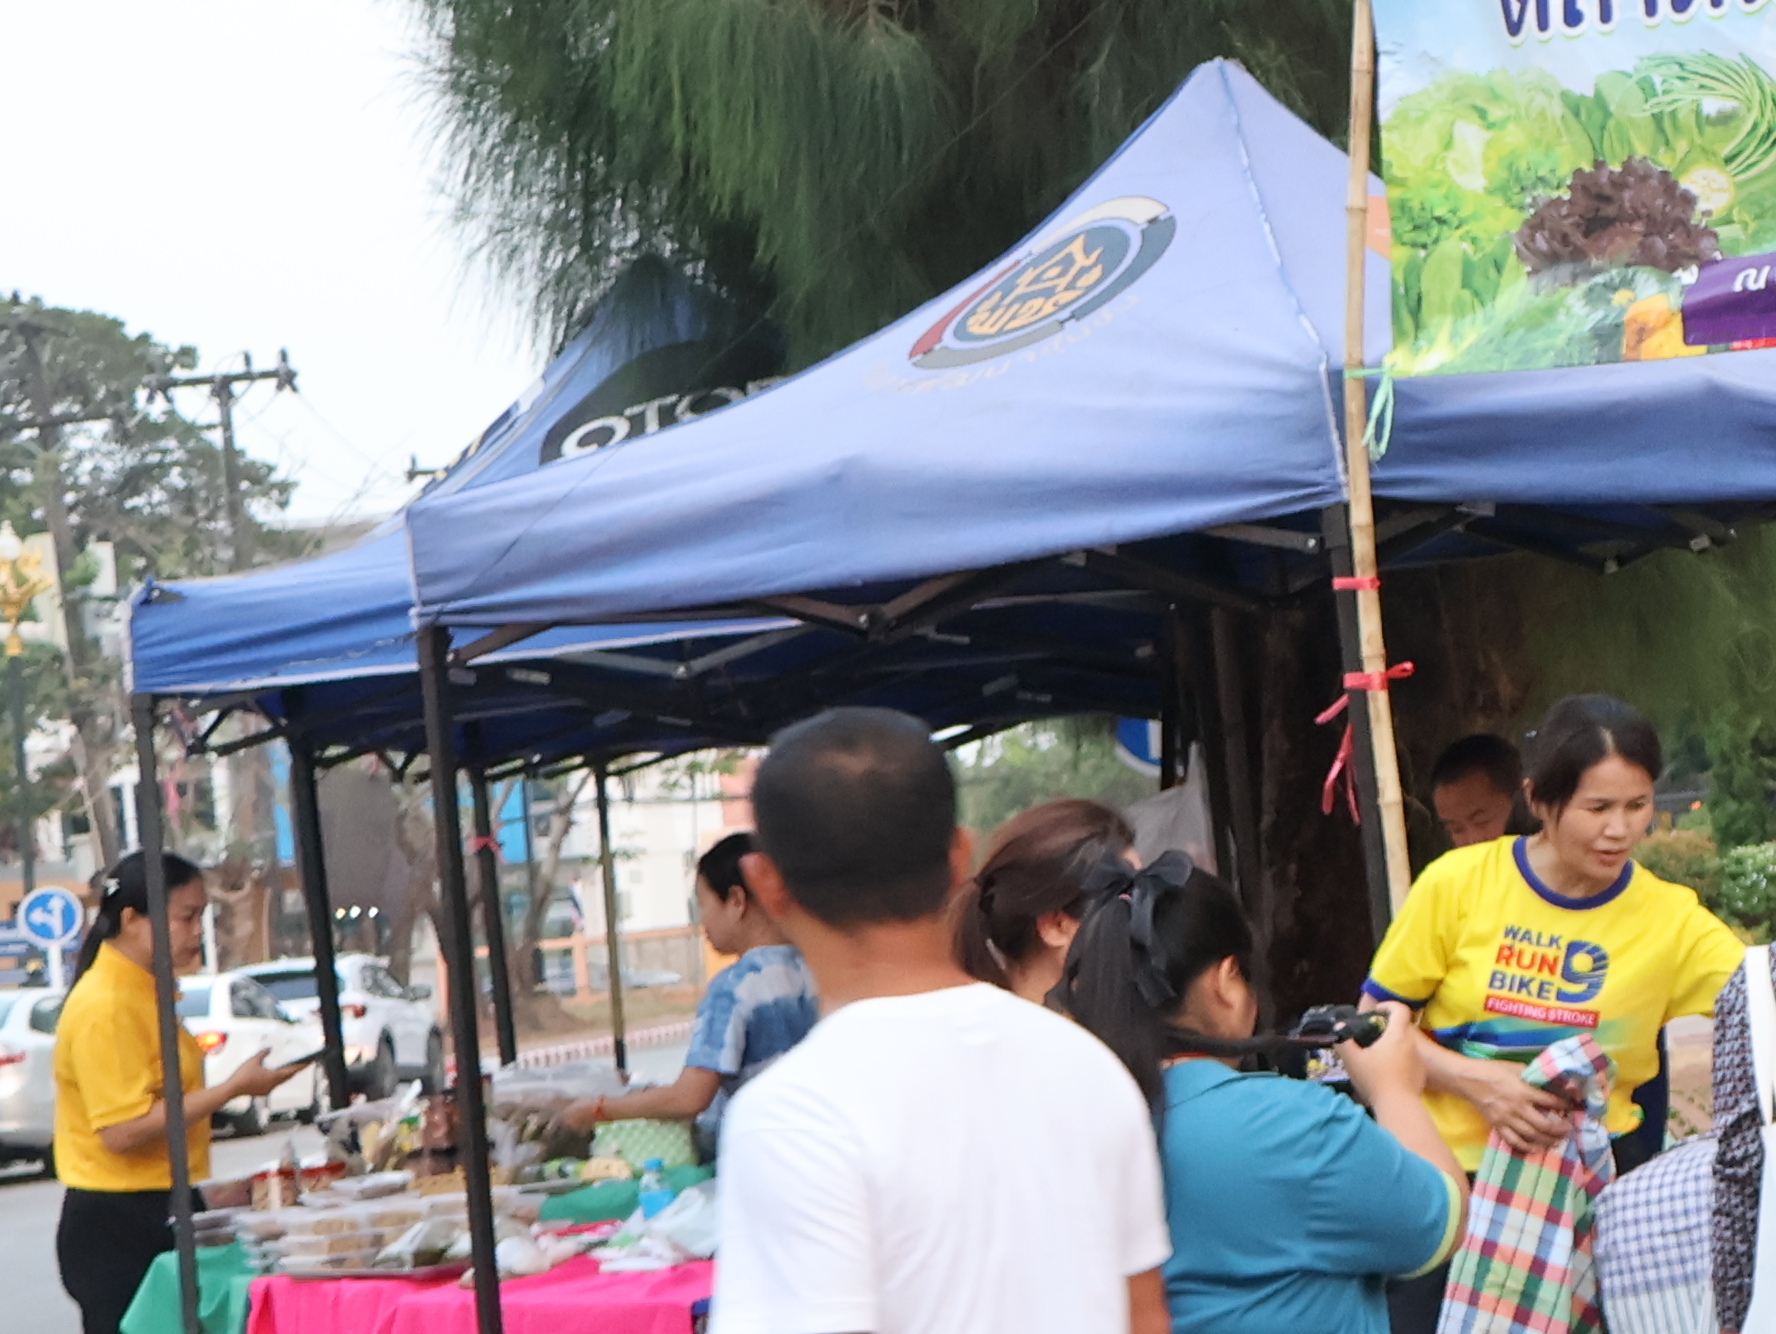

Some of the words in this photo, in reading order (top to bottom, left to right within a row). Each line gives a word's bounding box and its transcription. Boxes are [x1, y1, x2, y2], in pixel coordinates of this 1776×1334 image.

[1734, 269, 1766, 293] ณ
[561, 375, 791, 458] OTO
[1504, 925, 1563, 950] WALK
[1488, 969, 1554, 1001] BIKE
[1495, 944, 1560, 977] RUN
[1556, 940, 1609, 1004] 9
[1486, 997, 1547, 1017] FIGHTING
[1547, 1008, 1596, 1026] STROKE
